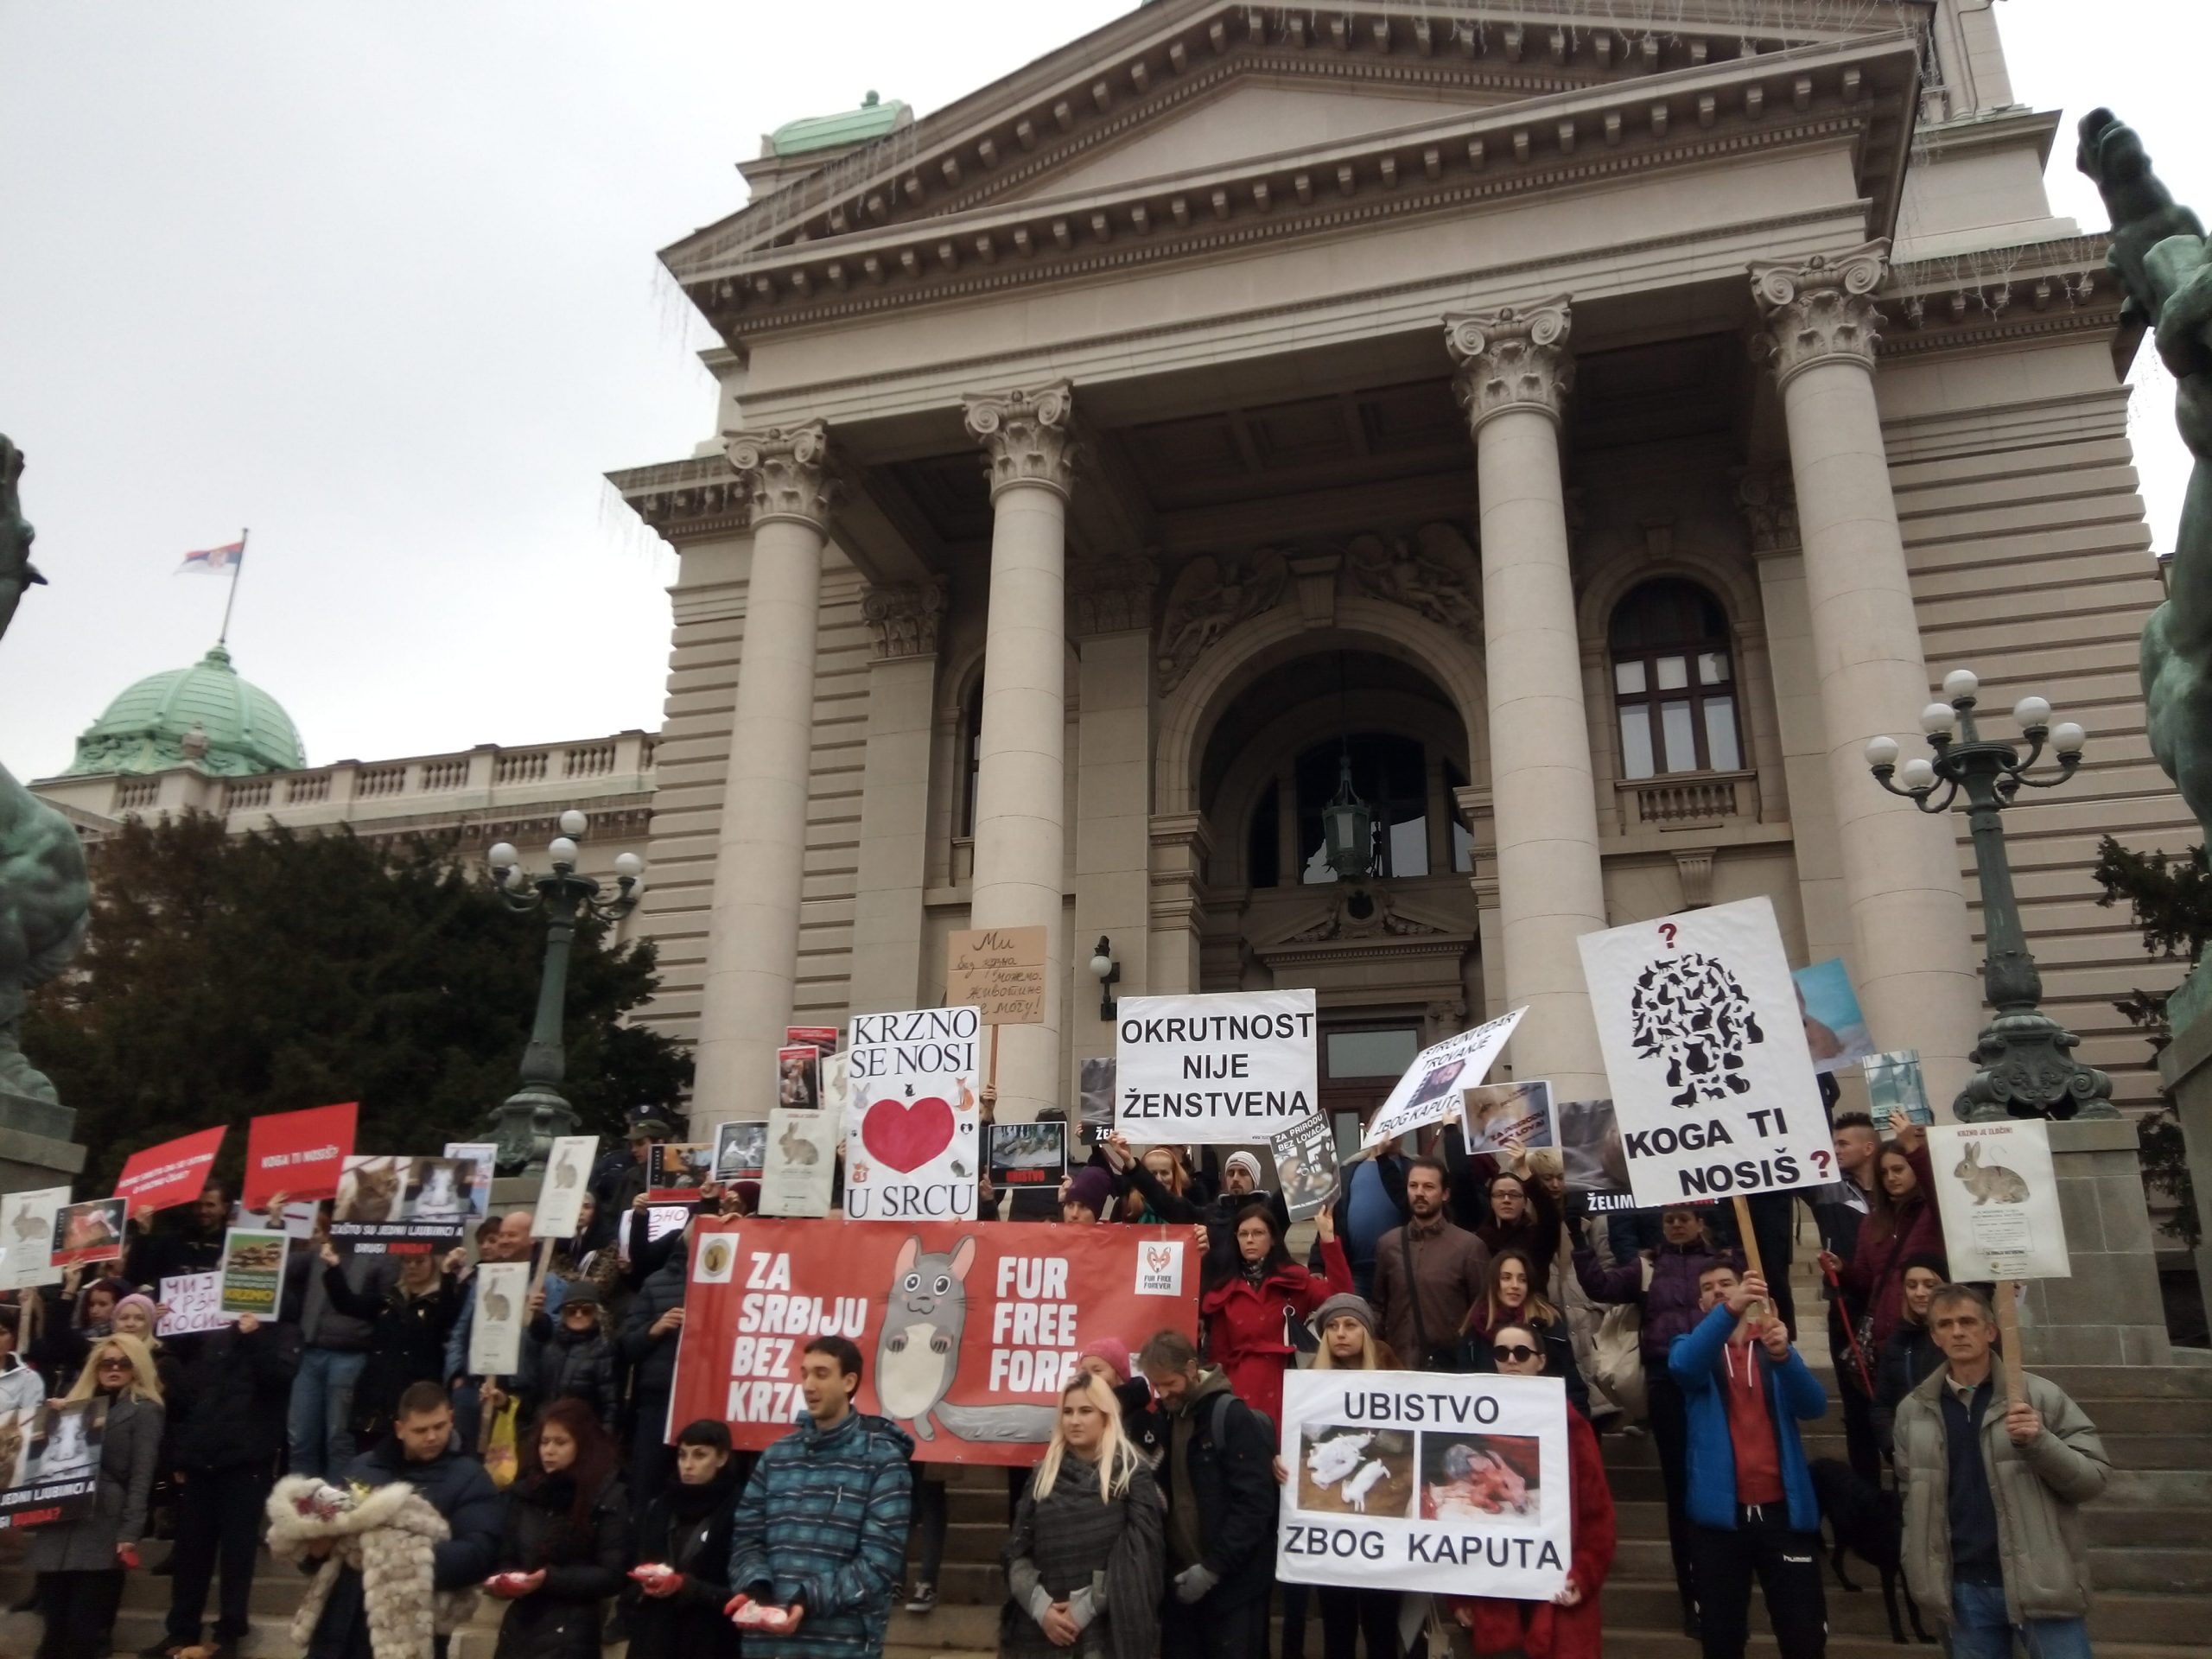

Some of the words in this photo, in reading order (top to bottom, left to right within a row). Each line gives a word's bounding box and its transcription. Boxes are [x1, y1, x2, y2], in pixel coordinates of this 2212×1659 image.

[972, 931, 1015, 951] Ми
[1657, 923, 1677, 949] ?
[980, 1002, 989, 1015] е
[993, 995, 1040, 1020] могу!
[851, 1009, 977, 1046] KRZNO
[1122, 1013, 1315, 1045] OKRUTNOST
[849, 1046, 887, 1079] SE
[894, 1042, 976, 1077] NOSI
[1183, 1053, 1249, 1080] NIJE
[1422, 1034, 1492, 1071] TROVANJE
[1122, 1087, 1312, 1119] ŽENSTVENA
[1275, 1133, 1287, 1143] ZA
[1289, 1114, 1323, 1137] PRIRODU
[1278, 1139, 1294, 1152] BEZ
[1296, 1123, 1326, 1144] LOVACA
[1374, 1111, 1409, 1136] ZBOG
[1624, 1119, 1733, 1160] KOGA
[1747, 1108, 1789, 1138] TI
[847, 1189, 869, 1219] U
[881, 1185, 973, 1218] SRCU
[166, 1275, 214, 1294] ЧИЈ
[745, 1252, 791, 1292] ZA
[996, 1256, 1068, 1300] FUR
[738, 1295, 868, 1338] SRBIJU
[992, 1303, 1077, 1347] FREE
[730, 1336, 795, 1377] BEZ
[988, 1349, 1079, 1393] FORE
[726, 1380, 810, 1425] KRZN
[1343, 1392, 1500, 1425] UBISTVO
[86, 1479, 97, 1493] A
[1283, 1525, 1385, 1560] ZBOG
[1408, 1533, 1564, 1573] KAPUTA
